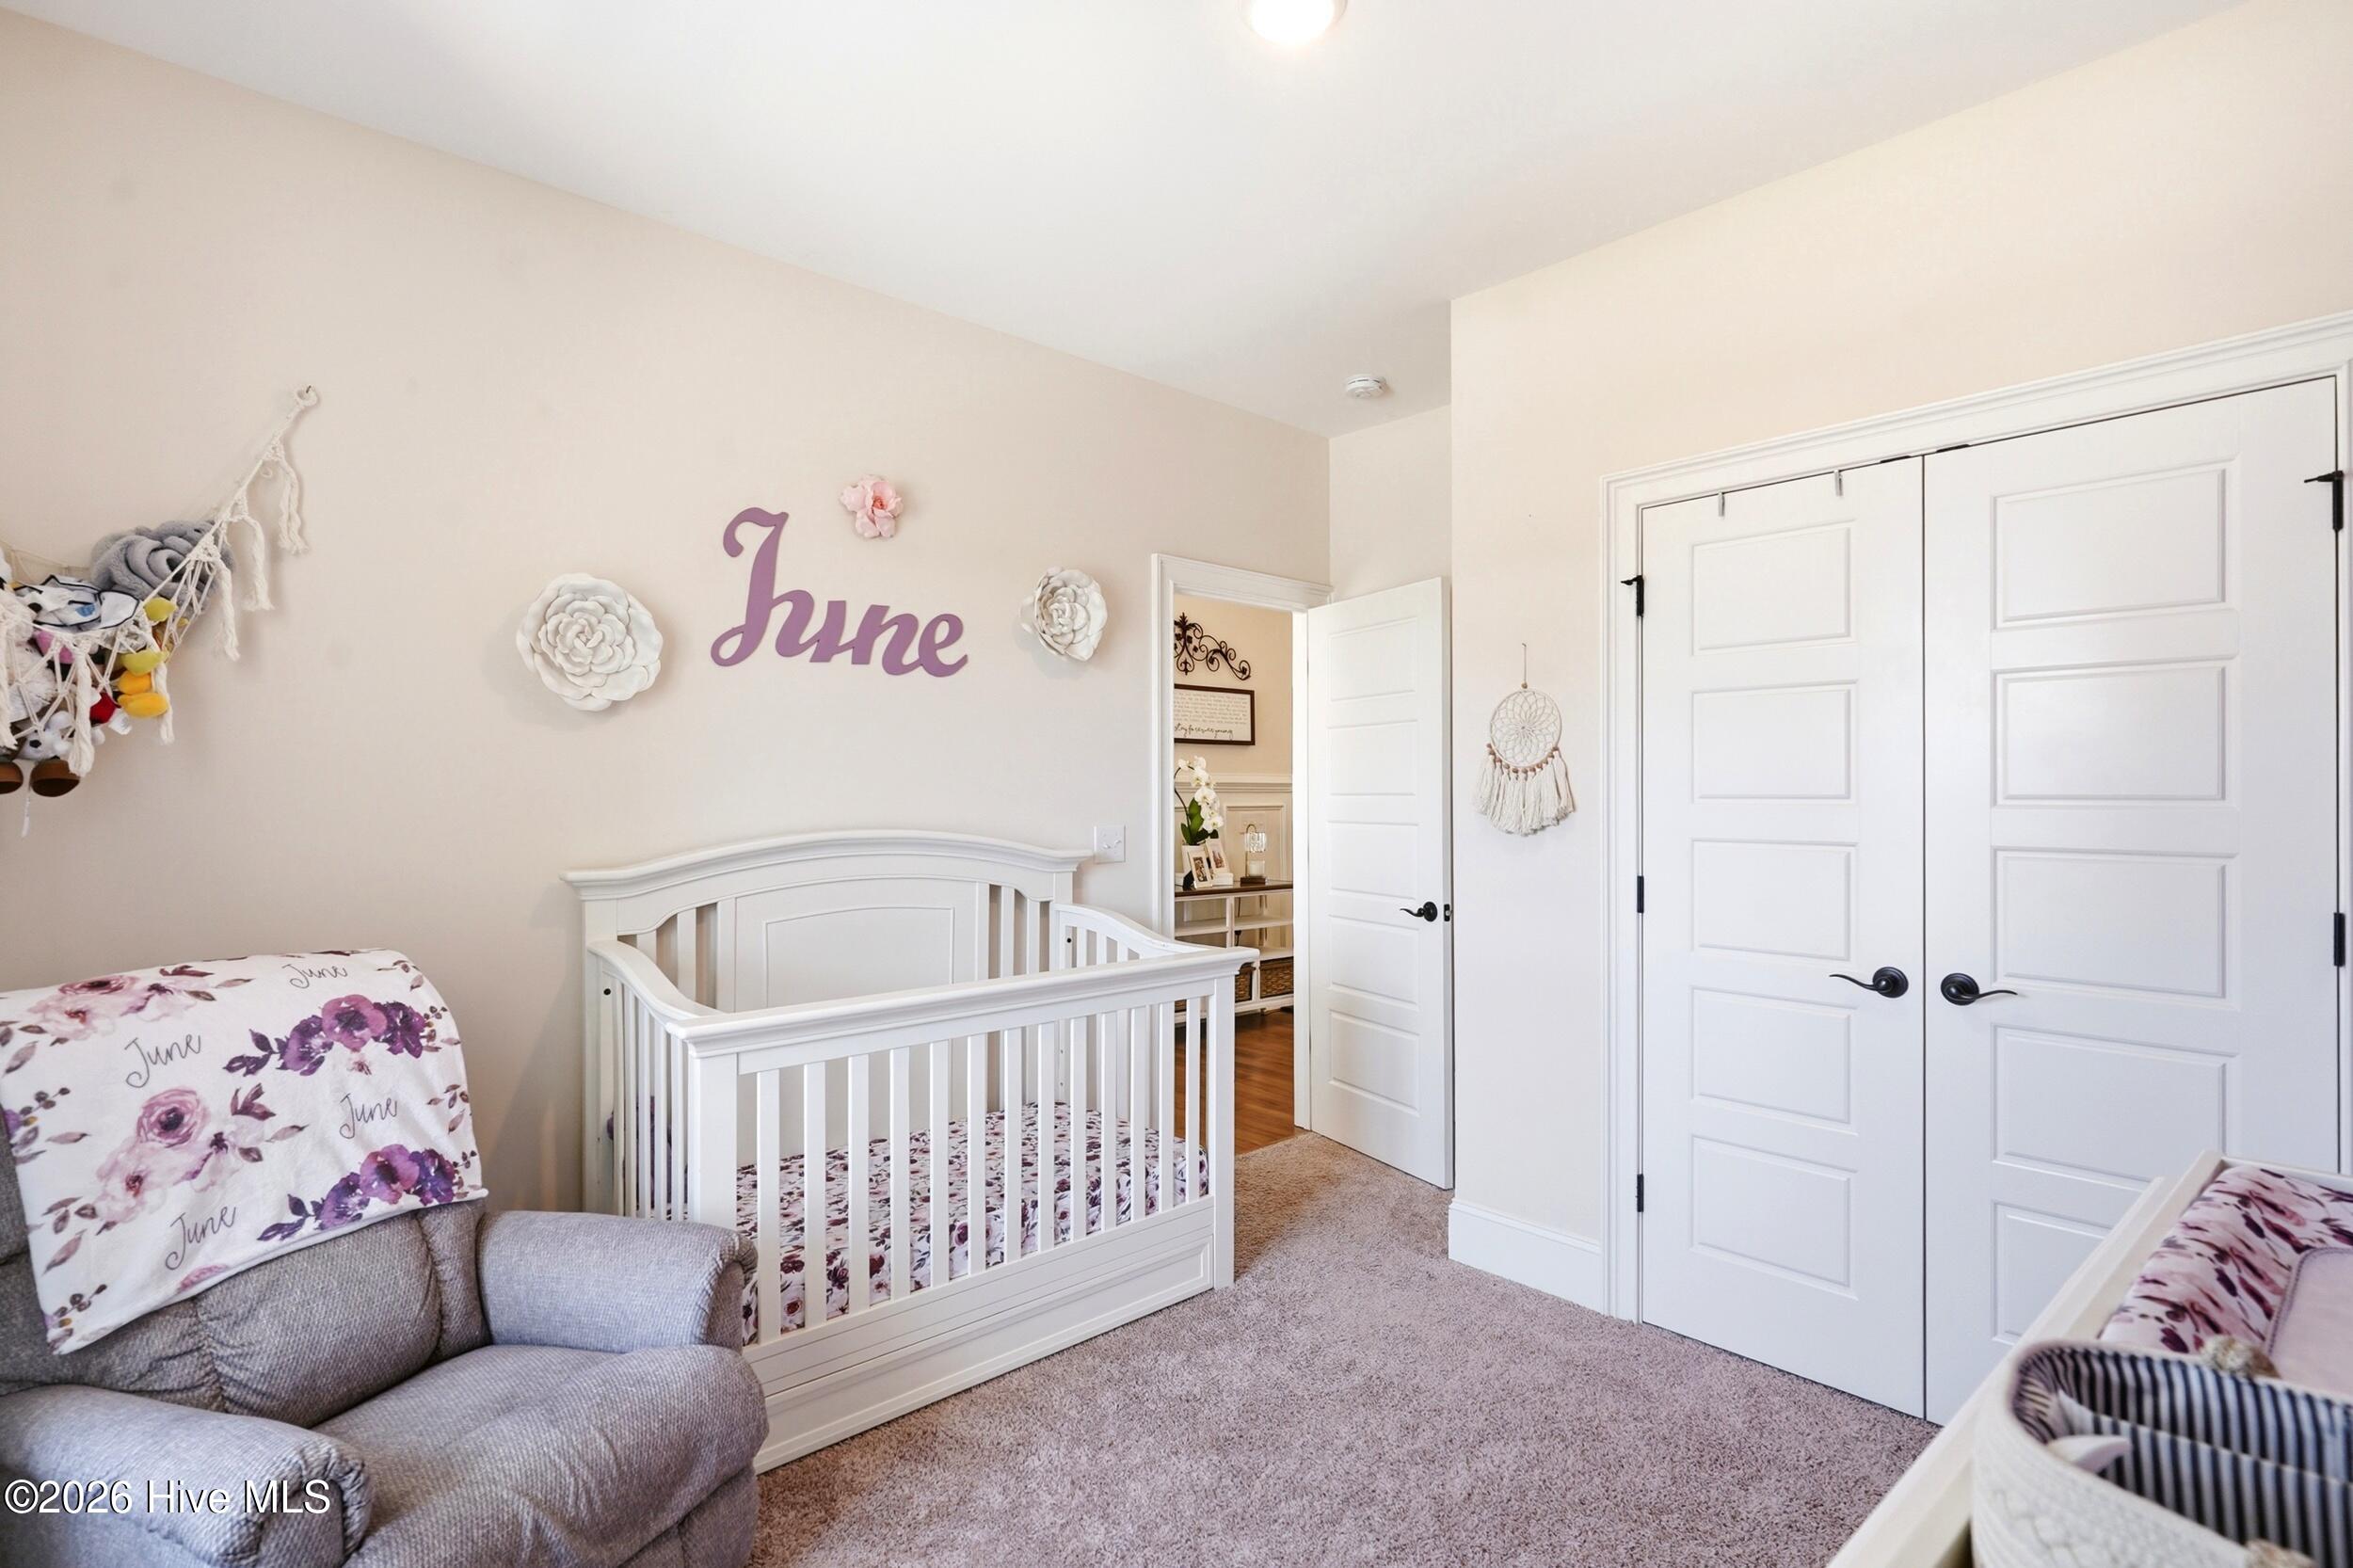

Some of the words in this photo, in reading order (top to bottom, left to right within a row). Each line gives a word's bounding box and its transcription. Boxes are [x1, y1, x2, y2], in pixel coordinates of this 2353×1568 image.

[711, 506, 968, 678] June
[284, 963, 349, 989] June
[124, 1033, 202, 1089] June
[339, 1093, 398, 1140] June
[164, 1206, 237, 1271] June
